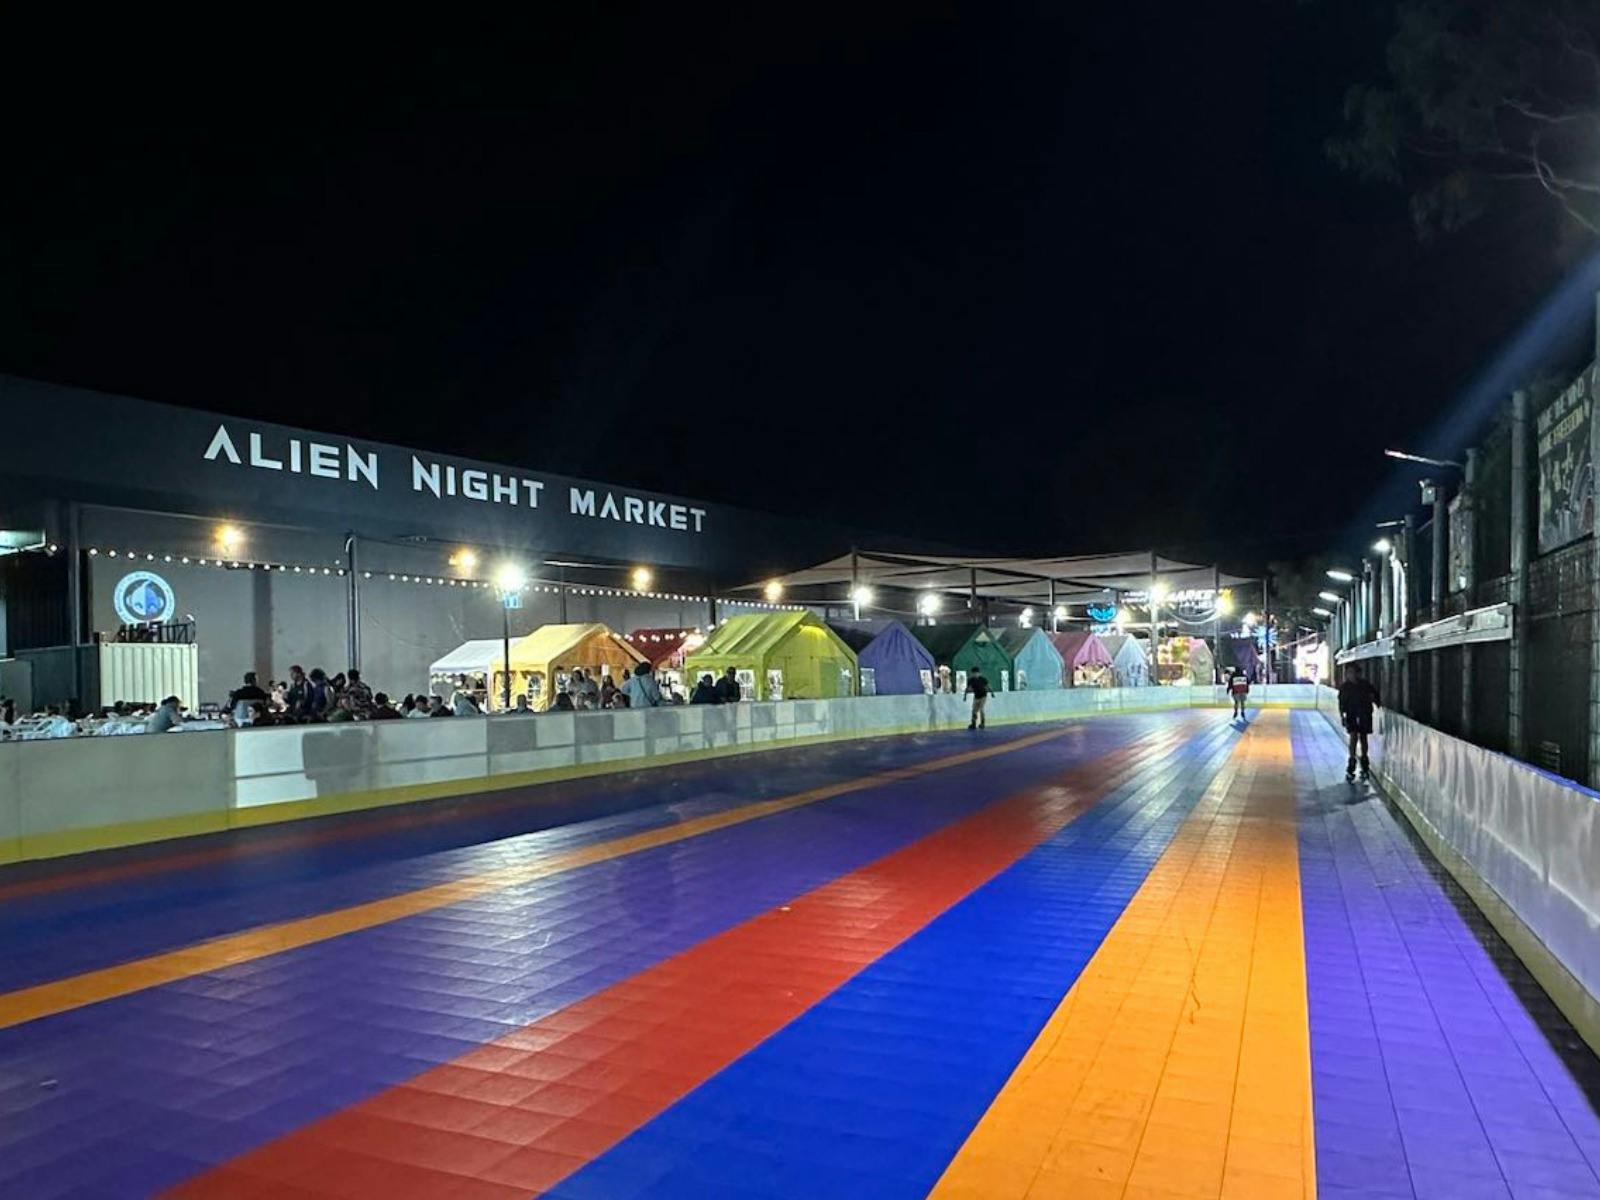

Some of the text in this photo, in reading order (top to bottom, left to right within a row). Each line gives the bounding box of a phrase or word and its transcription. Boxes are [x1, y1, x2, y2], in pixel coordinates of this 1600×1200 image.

[203, 424, 706, 532] ALIEN NIGHT MARKET
